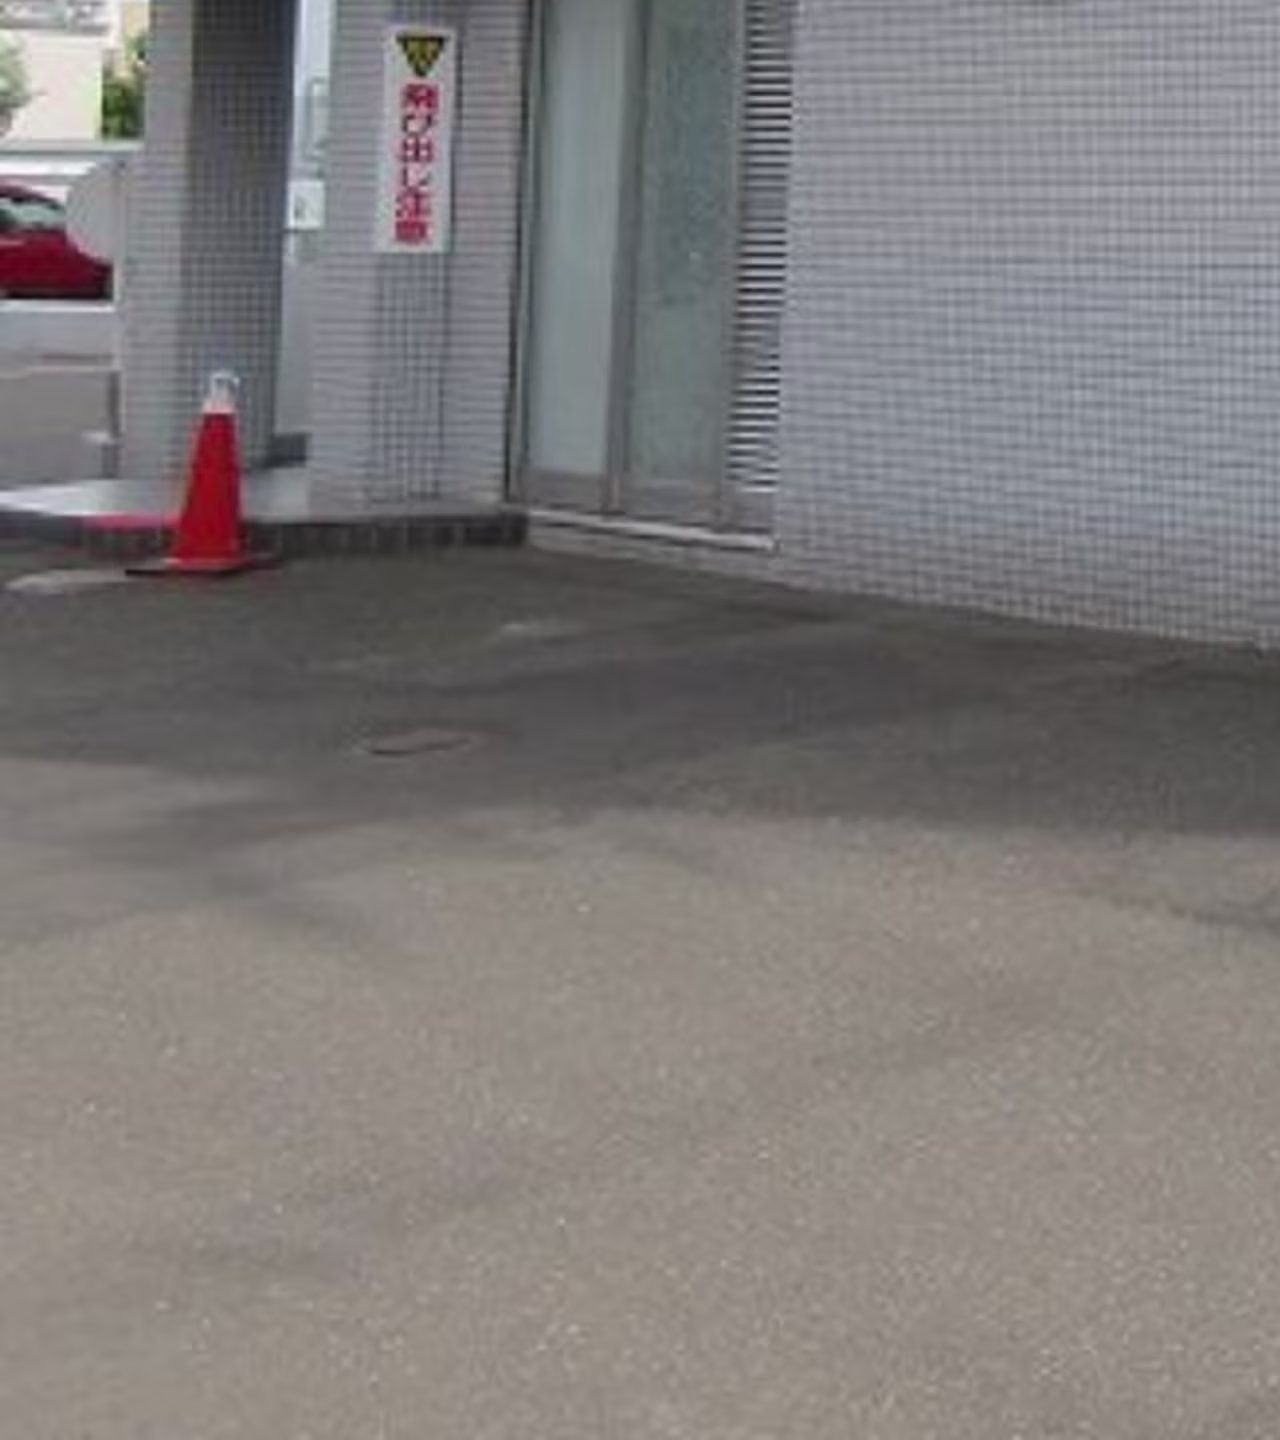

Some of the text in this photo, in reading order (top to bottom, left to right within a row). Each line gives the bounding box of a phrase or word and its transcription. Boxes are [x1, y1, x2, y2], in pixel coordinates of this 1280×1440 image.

[394, 83, 440, 244] 飛び出し注意
